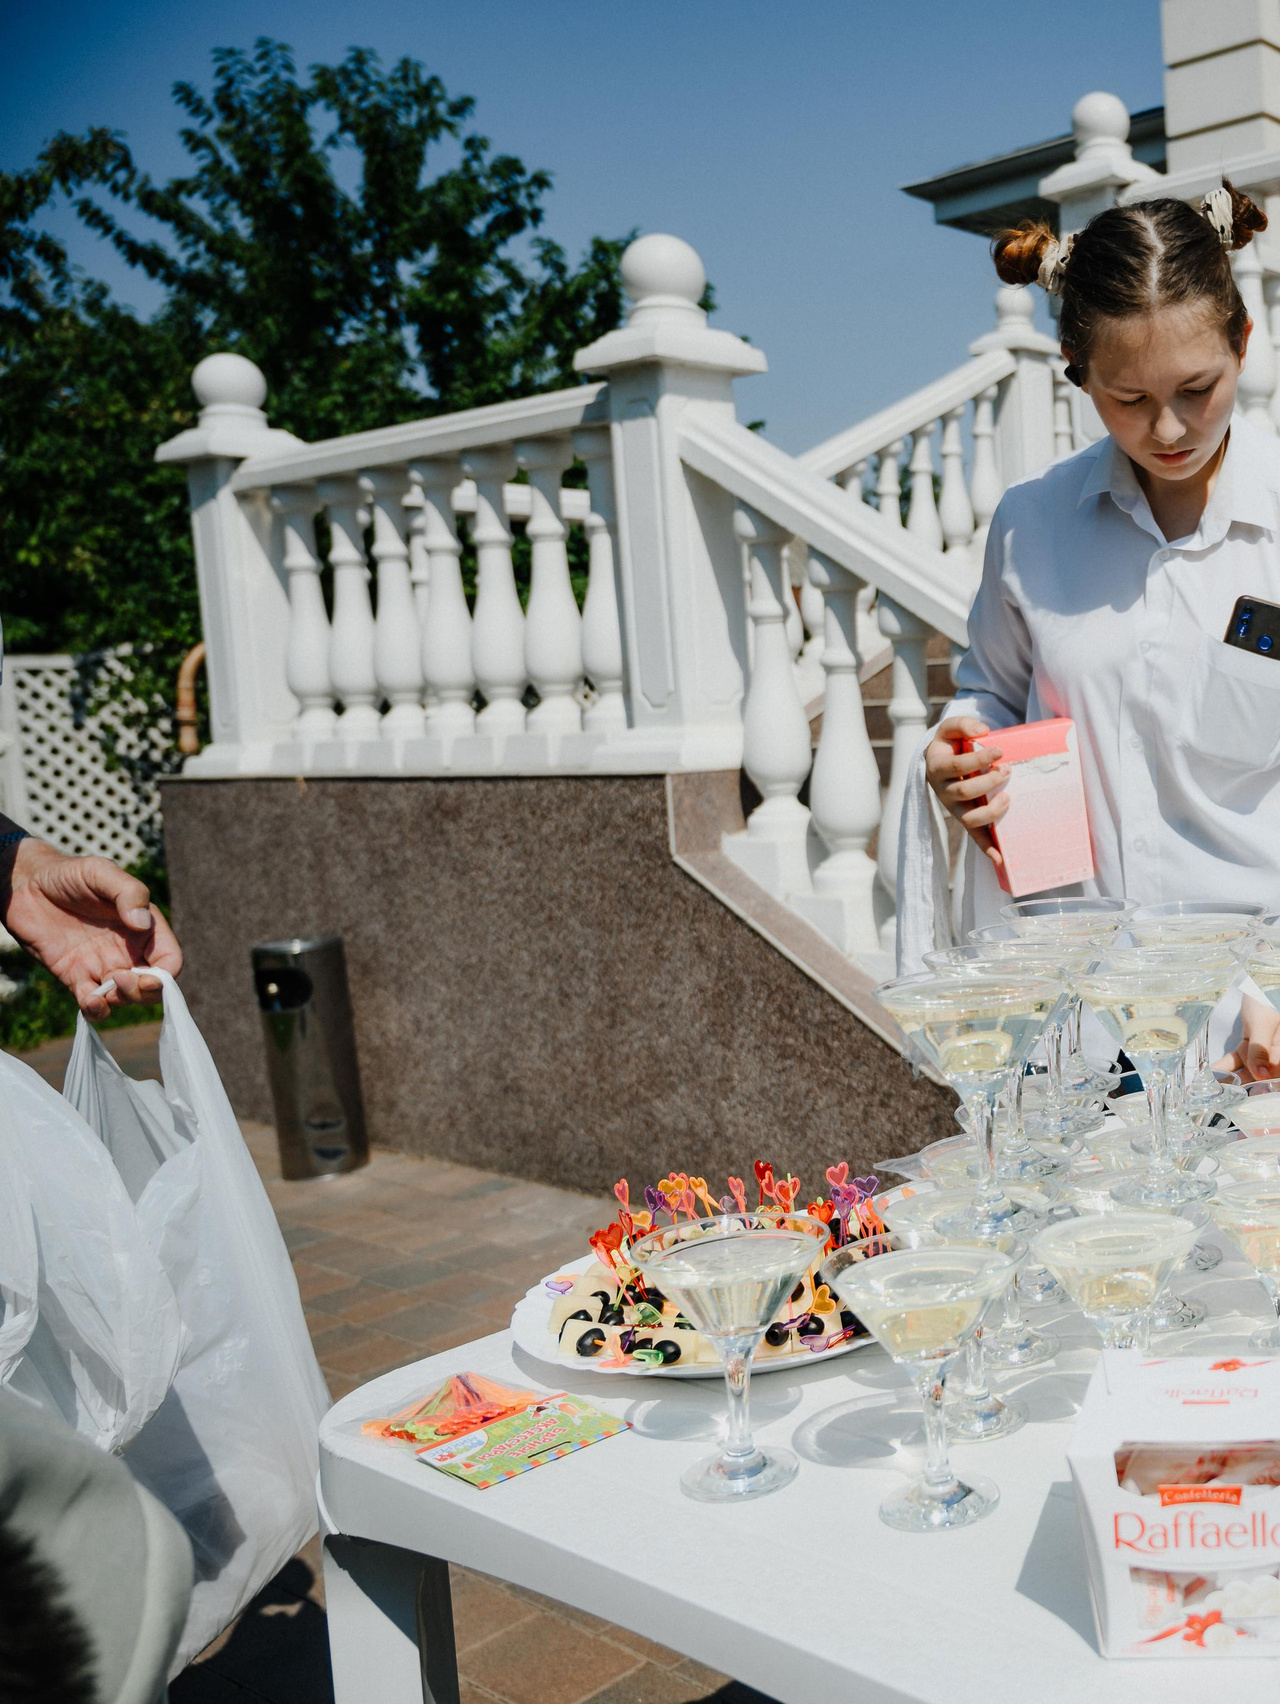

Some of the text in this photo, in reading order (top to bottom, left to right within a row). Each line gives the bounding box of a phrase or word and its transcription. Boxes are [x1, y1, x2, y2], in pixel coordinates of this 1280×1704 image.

[476, 1418, 559, 1461] АКСЕССУАРЫ
[507, 1427, 567, 1458] БАРНЫЕ
[1162, 1489, 1239, 1502] Confetteria
